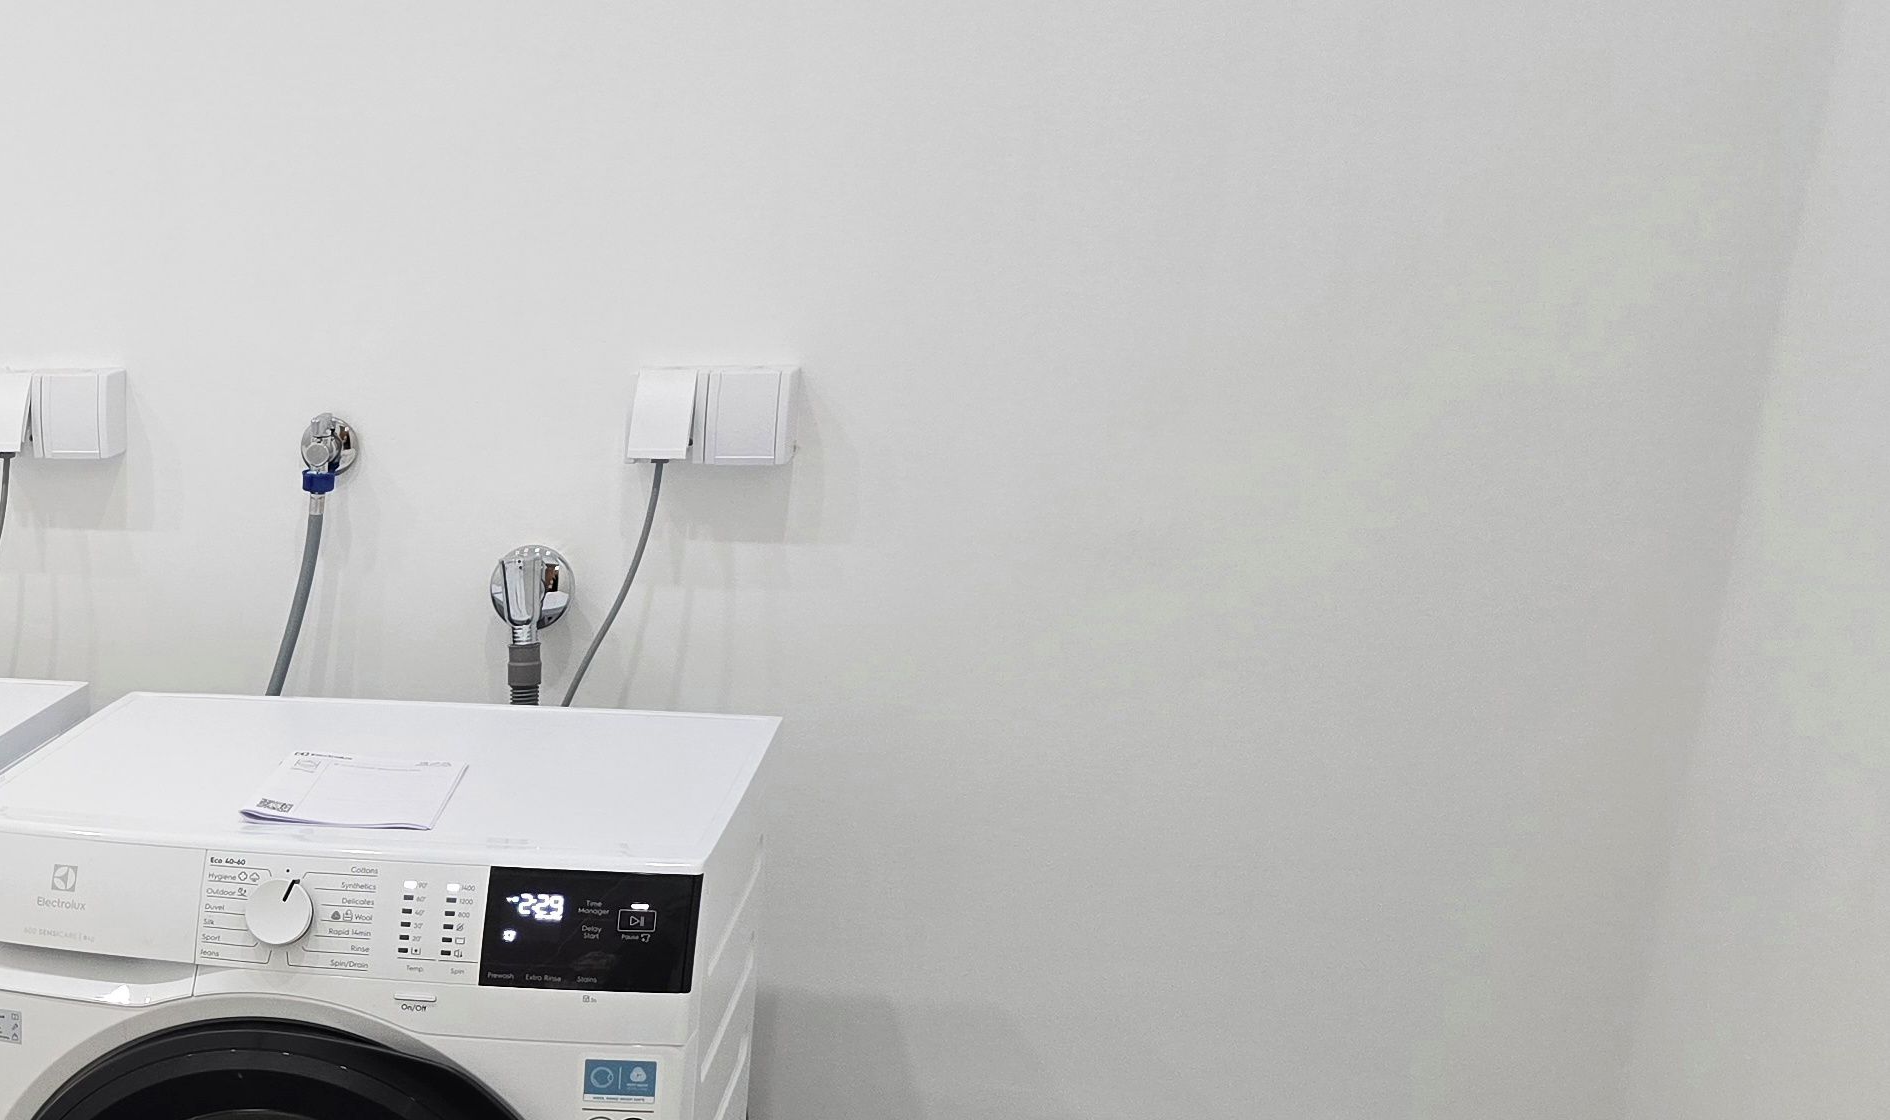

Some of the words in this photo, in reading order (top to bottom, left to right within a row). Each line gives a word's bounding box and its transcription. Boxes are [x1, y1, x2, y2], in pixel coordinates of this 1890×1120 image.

[210, 856, 223, 864] Eco
[224, 858, 246, 866] 40-60
[350, 866, 378, 875] Cottons
[208, 872, 236, 882] Hygiene
[341, 882, 377, 891] Synthetics
[206, 888, 236, 896] Outdoor
[36, 896, 86, 911] Electrolux
[341, 898, 375, 906] Delicates
[586, 900, 602, 908] Time
[578, 908, 610, 916] Manager
[203, 918, 215, 926] Silk
[354, 914, 373, 922] Wool
[328, 928, 350, 936] Rapid
[351, 928, 372, 937] 14min
[582, 925, 602, 934] Delay
[201, 933, 221, 942] Sport
[583, 932, 600, 940] Start
[200, 949, 220, 957] Jeans
[350, 945, 370, 953] Rinse
[330, 959, 369, 968] Spin/Drain
[487, 972, 514, 980] Prewash
[525, 973, 542, 982] Extra
[543, 974, 562, 982] Rinse
[576, 976, 598, 984] Stains
[400, 1004, 428, 1012] On/Off
